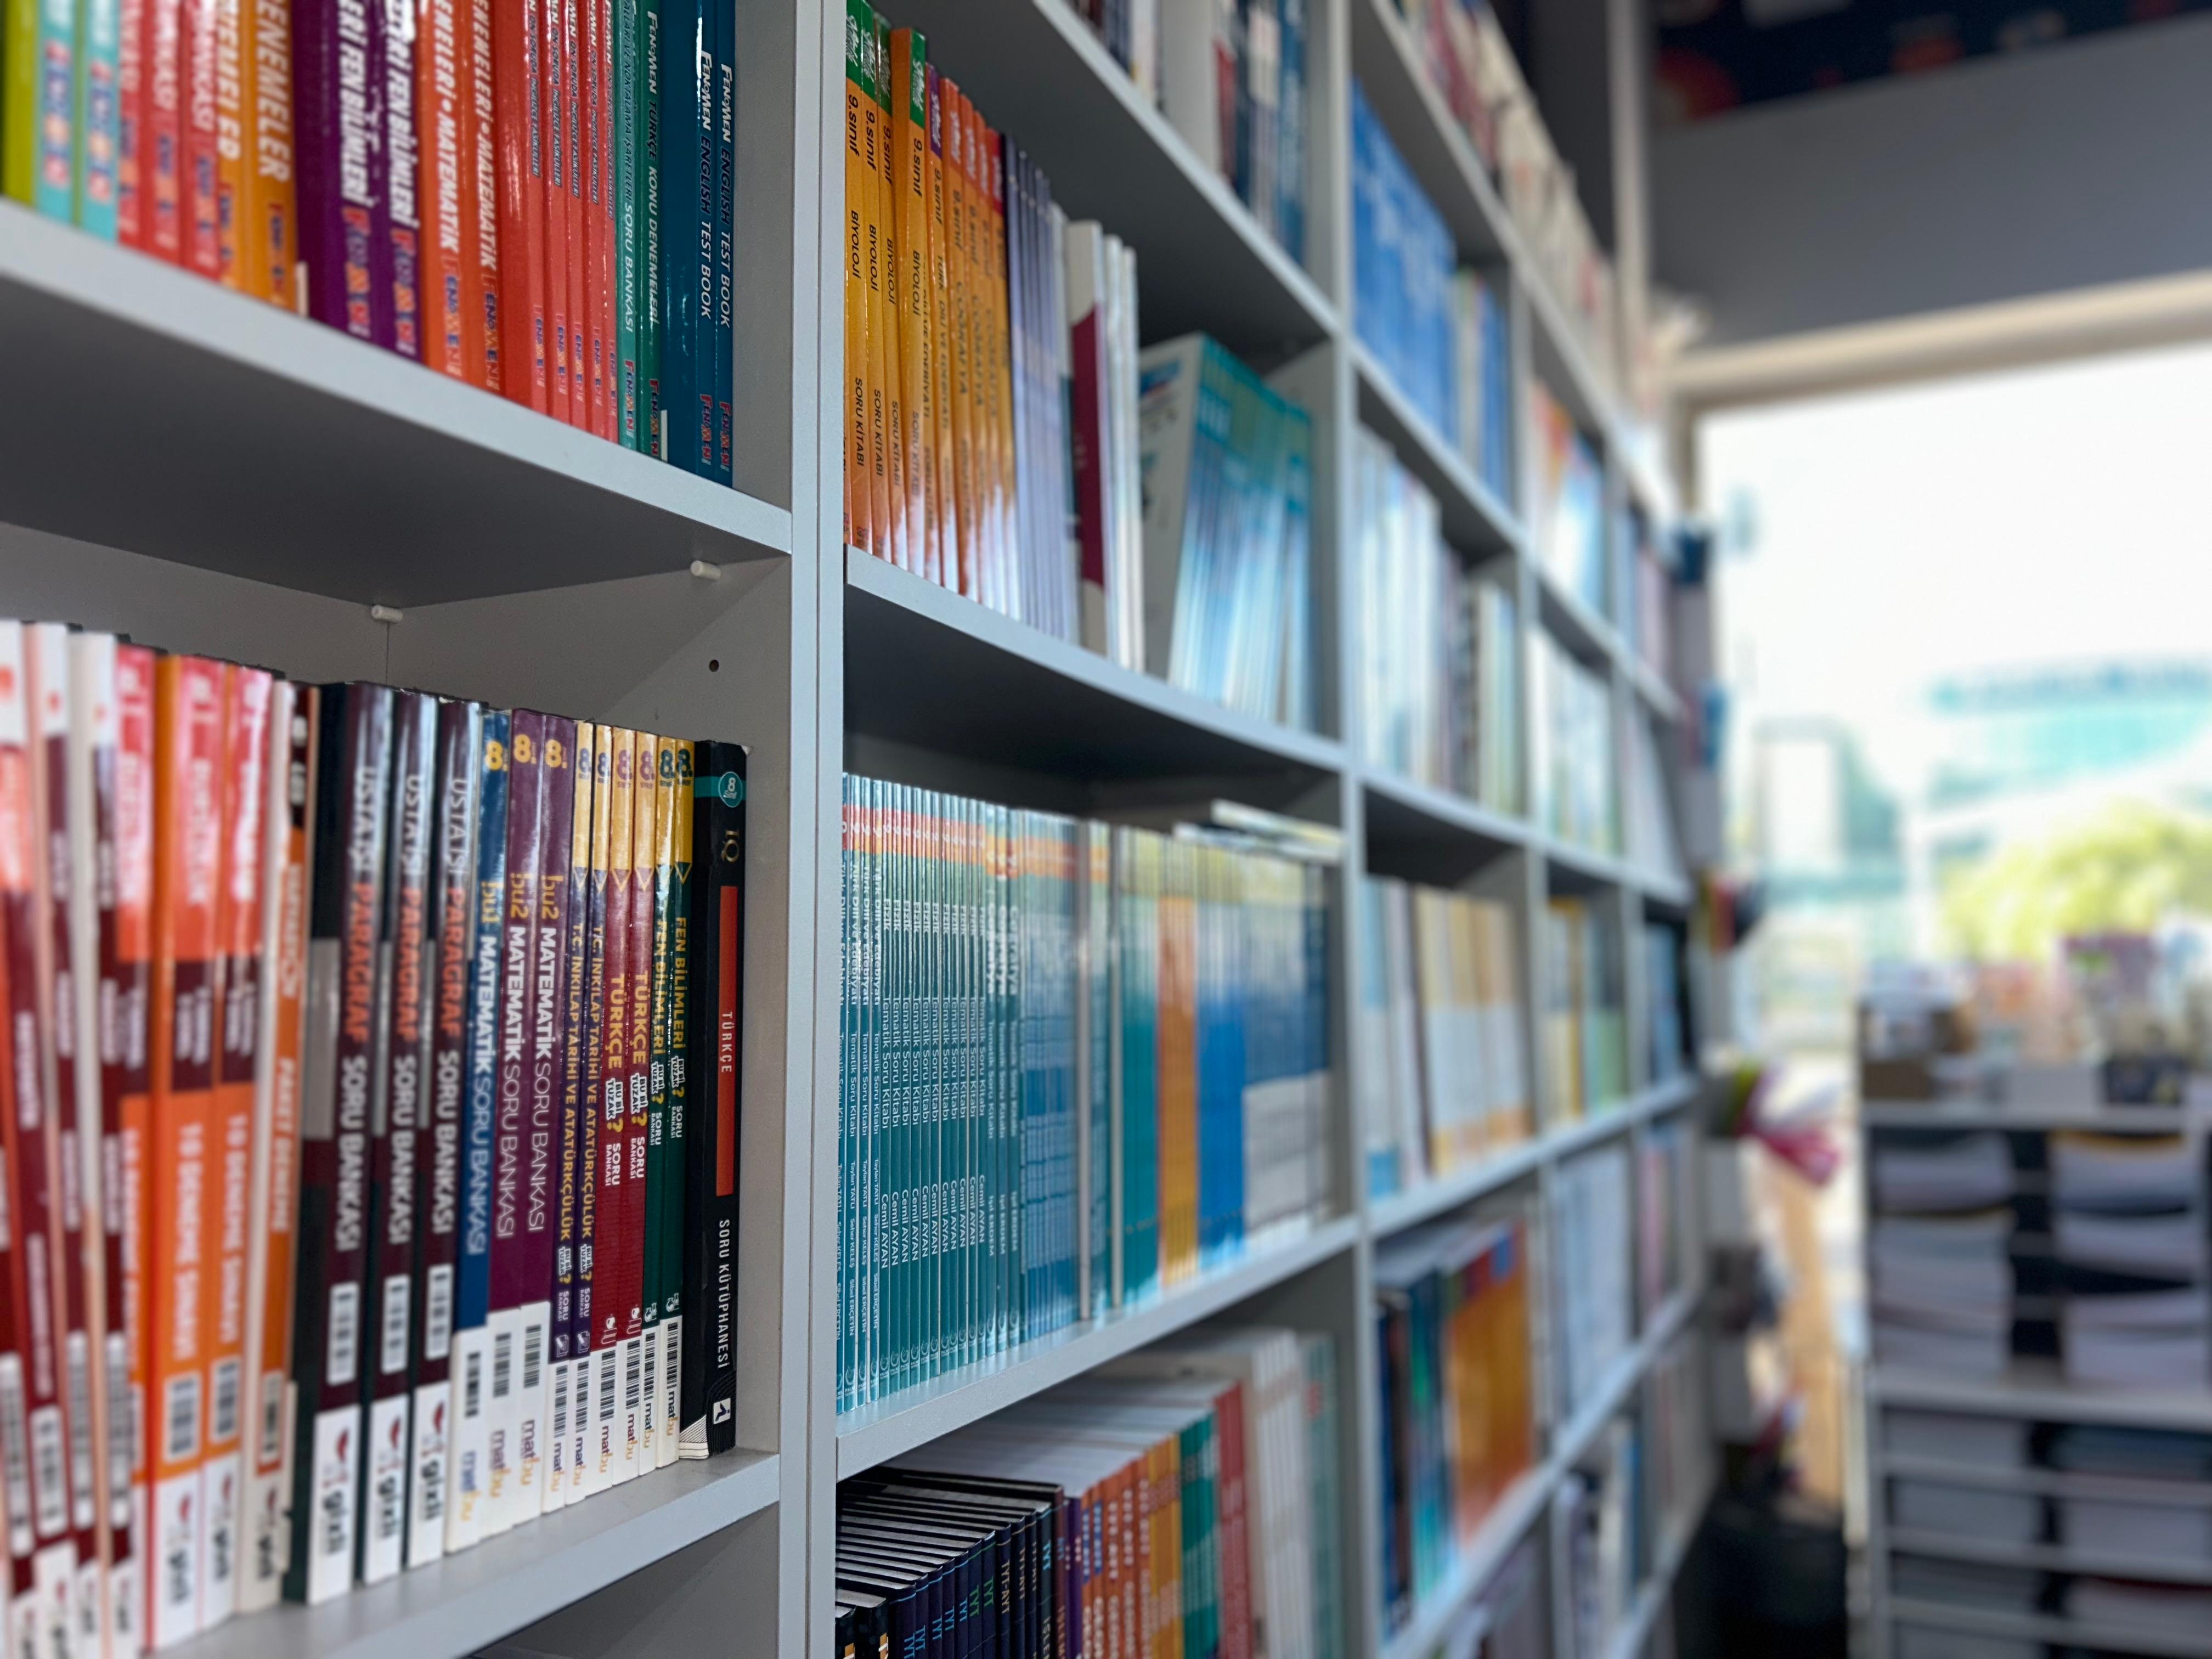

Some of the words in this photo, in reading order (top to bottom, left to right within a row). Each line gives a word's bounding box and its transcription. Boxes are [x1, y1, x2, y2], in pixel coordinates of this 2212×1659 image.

[646, 100, 658, 162] TÜRKÇE
[437, 111, 459, 253] MATEMATİK
[477, 134, 496, 271] MATEMATİK
[648, 166, 657, 215] KONU
[701, 136, 712, 216] ENGLISH
[720, 146, 731, 225] ENGLISH
[649, 218, 659, 324] DENEMELERİ
[701, 221, 712, 262] TEST
[721, 231, 731, 268] TEST
[851, 210, 861, 279] BİYOLOJİ
[625, 256, 633, 332] BANKASI
[701, 264, 712, 320] BOOK
[720, 274, 731, 328] BOOK
[912, 250, 922, 317] BİYOLOJİ
[869, 224, 879, 292] BİYOLOJİ
[875, 432, 884, 476] KİTABI
[887, 238, 896, 306] BİYOLOJİ
[893, 443, 901, 486] KİTABI
[855, 377, 864, 417] SORU
[856, 421, 865, 466] KİTABI
[722, 831, 739, 862] IQ
[346, 884, 375, 1042] PARAGRAF
[399, 887, 422, 1041] PARAGRAF
[442, 888, 465, 1037] PARAGRAF
[572, 924, 584, 951] T.C.
[676, 917, 687, 952] FEN
[475, 936, 496, 1074] MATEMATİK
[505, 927, 526, 1062] MATEMATİK
[536, 928, 556, 1060] MATEMATİK
[570, 956, 583, 1022] İNKILAP
[591, 958, 603, 1023] İNKILAP
[605, 973, 627, 1069] TÜRKÇE
[629, 970, 650, 1064] TÜRKÇE
[653, 962, 668, 1054] BİLİMLERİ
[673, 958, 688, 1048] BİLİMLERİ
[567, 1025, 581, 1080] TARİHİ
[588, 1026, 601, 1080] TARİHİ
[720, 1012, 734, 1074] TÜRKÇE
[341, 1055, 366, 1128] SORU
[393, 1055, 416, 1126] SORU
[437, 1050, 460, 1119] SORU
[473, 1077, 493, 1143] SORU
[501, 1065, 520, 1130] SORU
[533, 1063, 551, 1126] SORU
[566, 1084, 577, 1104] VE
[587, 1084, 597, 1104] VE
[606, 1080, 615, 1119] TUZAK
[616, 1084, 623, 1098] BU
[631, 1075, 640, 1113] TUZAK
[640, 1077, 646, 1092] BU
[389, 1130, 414, 1244] BANKASI
[433, 1123, 456, 1234] BANKASI
[497, 1136, 518, 1237] BANKASI
[528, 1132, 548, 1231] BANKASI
[560, 1108, 577, 1240] ATATÜRKÇÜLÜK
[582, 1108, 597, 1238] ATATÜRKÇÜLÜK
[612, 1143, 621, 1185] SORU
[636, 1137, 645, 1178] SORU
[336, 1132, 364, 1251] BANKASI
[467, 1149, 489, 1255] BANKASI
[719, 1220, 730, 1258] SORU
[718, 1265, 731, 1369] KÜTÜPHANESİ
[1043, 1540, 1051, 1570] TYT
[945, 1606, 955, 1631] TYT
[960, 1598, 968, 1622] TYT
[969, 1584, 979, 1617] TYT
[984, 1576, 994, 1607] TYT
[915, 1625, 926, 1651] TYT
[933, 1616, 943, 1640] TYT
